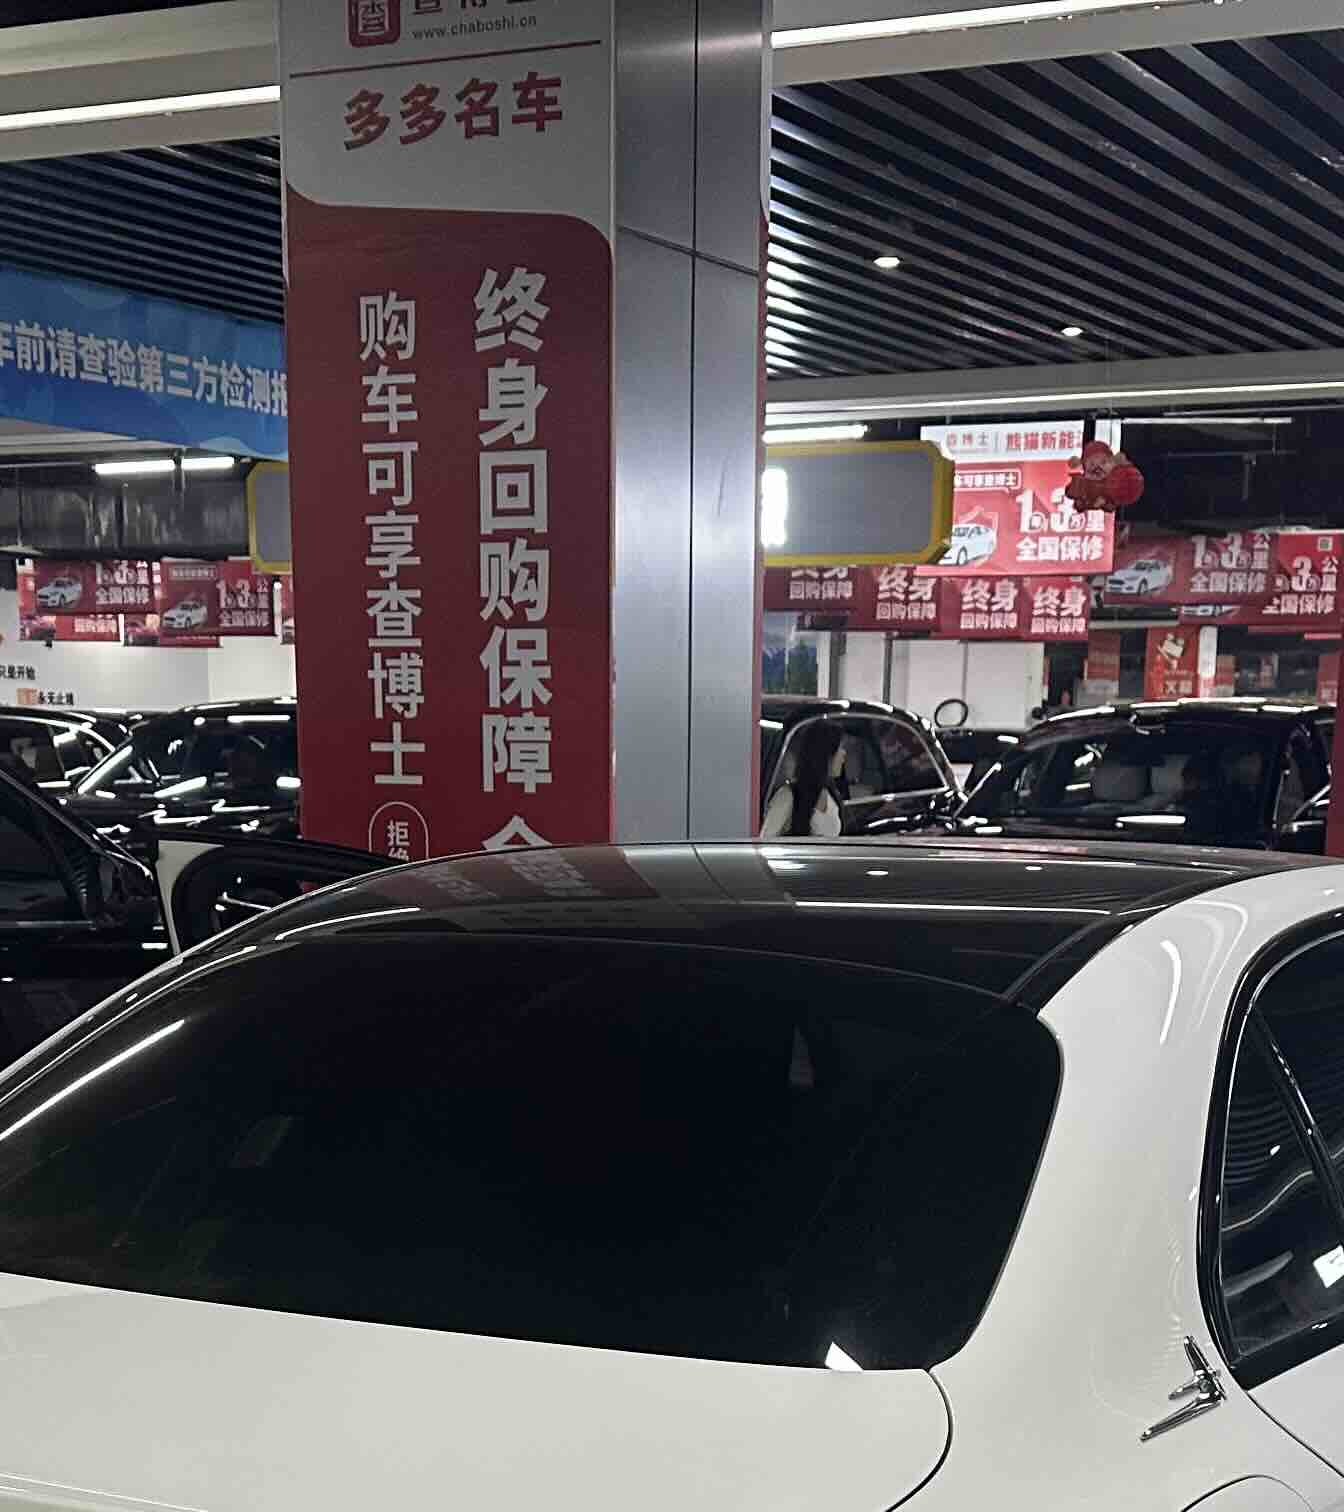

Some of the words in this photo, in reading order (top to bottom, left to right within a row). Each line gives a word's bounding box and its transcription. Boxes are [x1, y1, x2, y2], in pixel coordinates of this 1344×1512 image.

[412, 14, 537, 39] www.chaboshi.cn
[344, 71, 563, 150] 多多名车
[360, 290, 425, 786] 购车可享查博士
[474, 267, 553, 793] 终身回购保障
[1015, 536, 1104, 561] 全国保修
[788, 579, 853, 600] 回购保障
[877, 565, 937, 601] 终身
[959, 577, 1019, 611] 终身
[1189, 571, 1266, 593] 全国保修
[875, 602, 937, 621] 回购保障
[1032, 585, 1088, 617] 终身
[959, 611, 1018, 630] 回购保障
[1030, 617, 1086, 634] 回购保障
